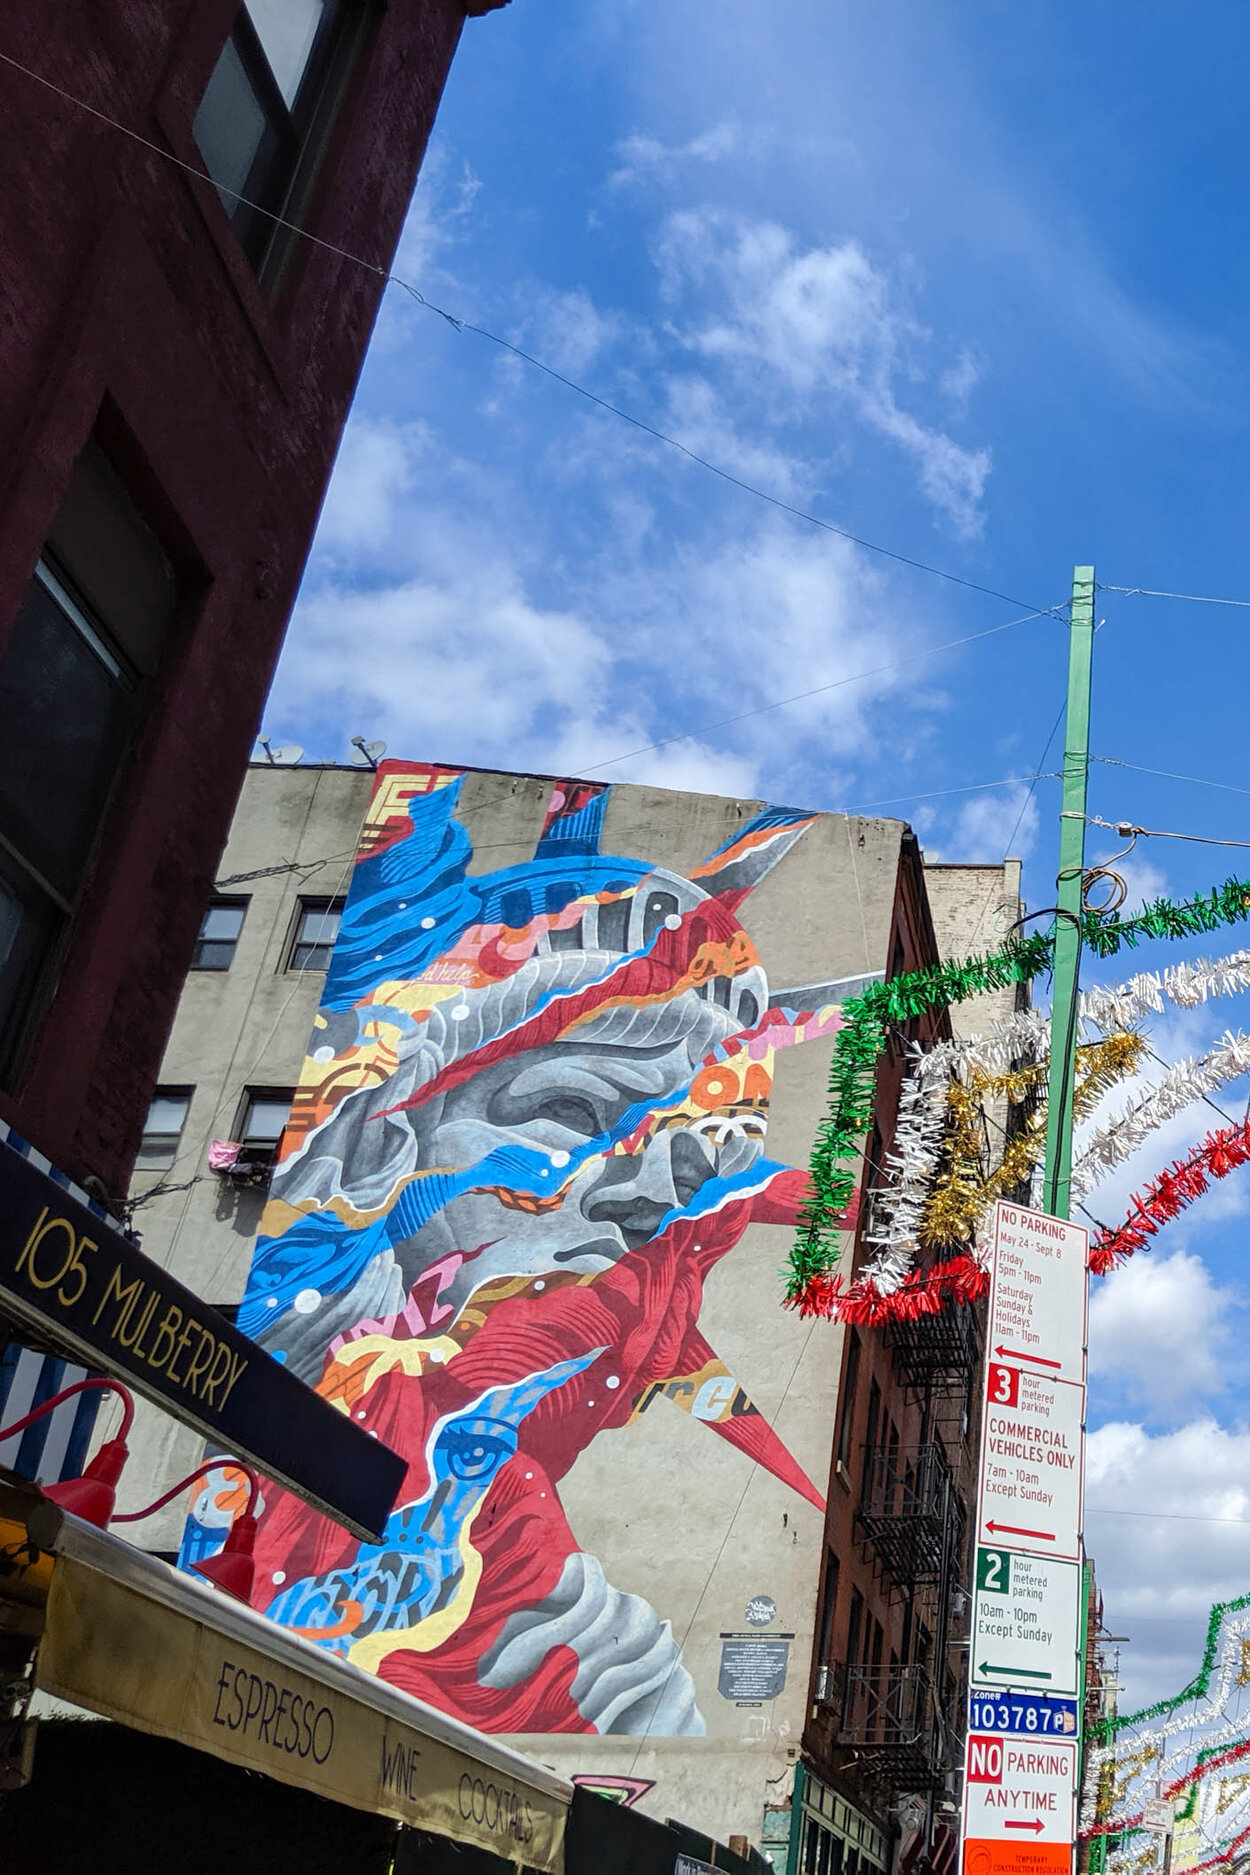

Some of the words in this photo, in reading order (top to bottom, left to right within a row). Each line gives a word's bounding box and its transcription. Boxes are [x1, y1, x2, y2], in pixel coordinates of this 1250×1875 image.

[1002, 1209, 1017, 1225] NO
[1021, 1215, 1066, 1241] PARKING
[1000, 1232, 1016, 1247] May
[1019, 1237, 1029, 1248] 24
[1036, 1242, 1053, 1257] Sept
[1056, 1248, 1062, 1259] 8
[1000, 1251, 1024, 1267] Friday
[999, 1263, 1016, 1277] 5pm
[1024, 1270, 1041, 1285] 11pm
[998, 1283, 1033, 1304] Saturday
[15, 1206, 99, 1307] 105
[93, 1263, 249, 1413] MULBERRY
[997, 1297, 1026, 1315] Sunday
[996, 1309, 1030, 1328] Holidays
[995, 1322, 1013, 1337] 11am
[1022, 1328, 1040, 1344] 11pm
[994, 1369, 1011, 1402] 3
[1023, 1376, 1040, 1390] hour
[1022, 1389, 1054, 1404] metered
[1021, 1401, 1050, 1418] parking
[990, 1418, 1068, 1449] COMMERCIAL
[989, 1438, 1043, 1463] VEHICLES
[1047, 1450, 1075, 1470] ONLY
[988, 1463, 1006, 1478] 7am
[1016, 1469, 1039, 1484] 10am
[986, 1480, 1017, 1498] Except
[1020, 1486, 1053, 1507] Sunday
[985, 1553, 1002, 1589] 2
[1014, 1560, 1032, 1571] hour
[1013, 1573, 1048, 1587] metered
[1013, 1586, 1043, 1603] parking
[980, 1603, 1003, 1619] 10am
[1014, 1608, 1037, 1624] 10pm
[979, 1620, 1013, 1638] Except
[1017, 1626, 1052, 1646] Sunday
[213, 1661, 334, 1765] ESPRESSO
[974, 1704, 1052, 1731] 103787
[382, 1735, 421, 1801] WINE
[970, 1743, 1000, 1777] NO
[1007, 1752, 1068, 1776] PARKING
[984, 1788, 1057, 1811] ANYTIME
